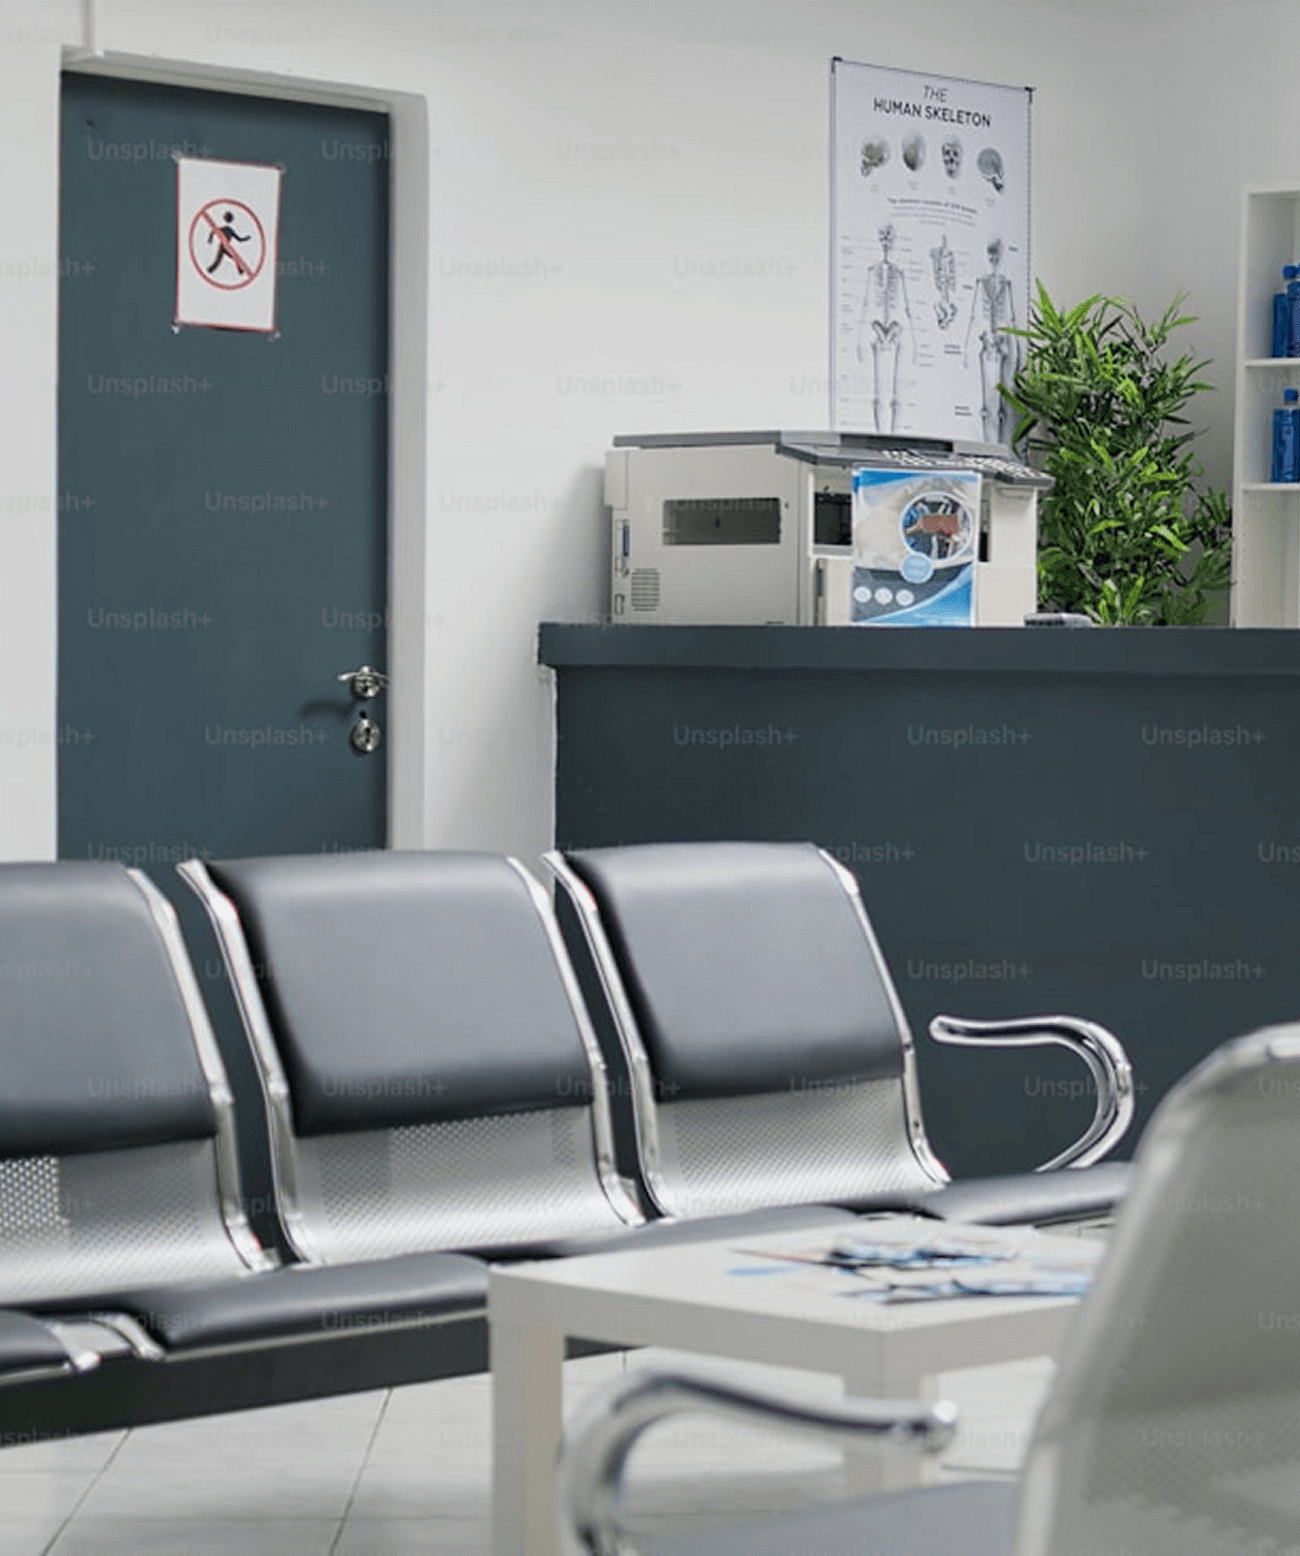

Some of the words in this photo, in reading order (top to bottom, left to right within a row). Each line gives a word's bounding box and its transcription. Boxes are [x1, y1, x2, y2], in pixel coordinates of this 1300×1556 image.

[924, 85, 949, 103] THE
[873, 97, 922, 118] HUMAN
[925, 104, 991, 128] SKELETON
